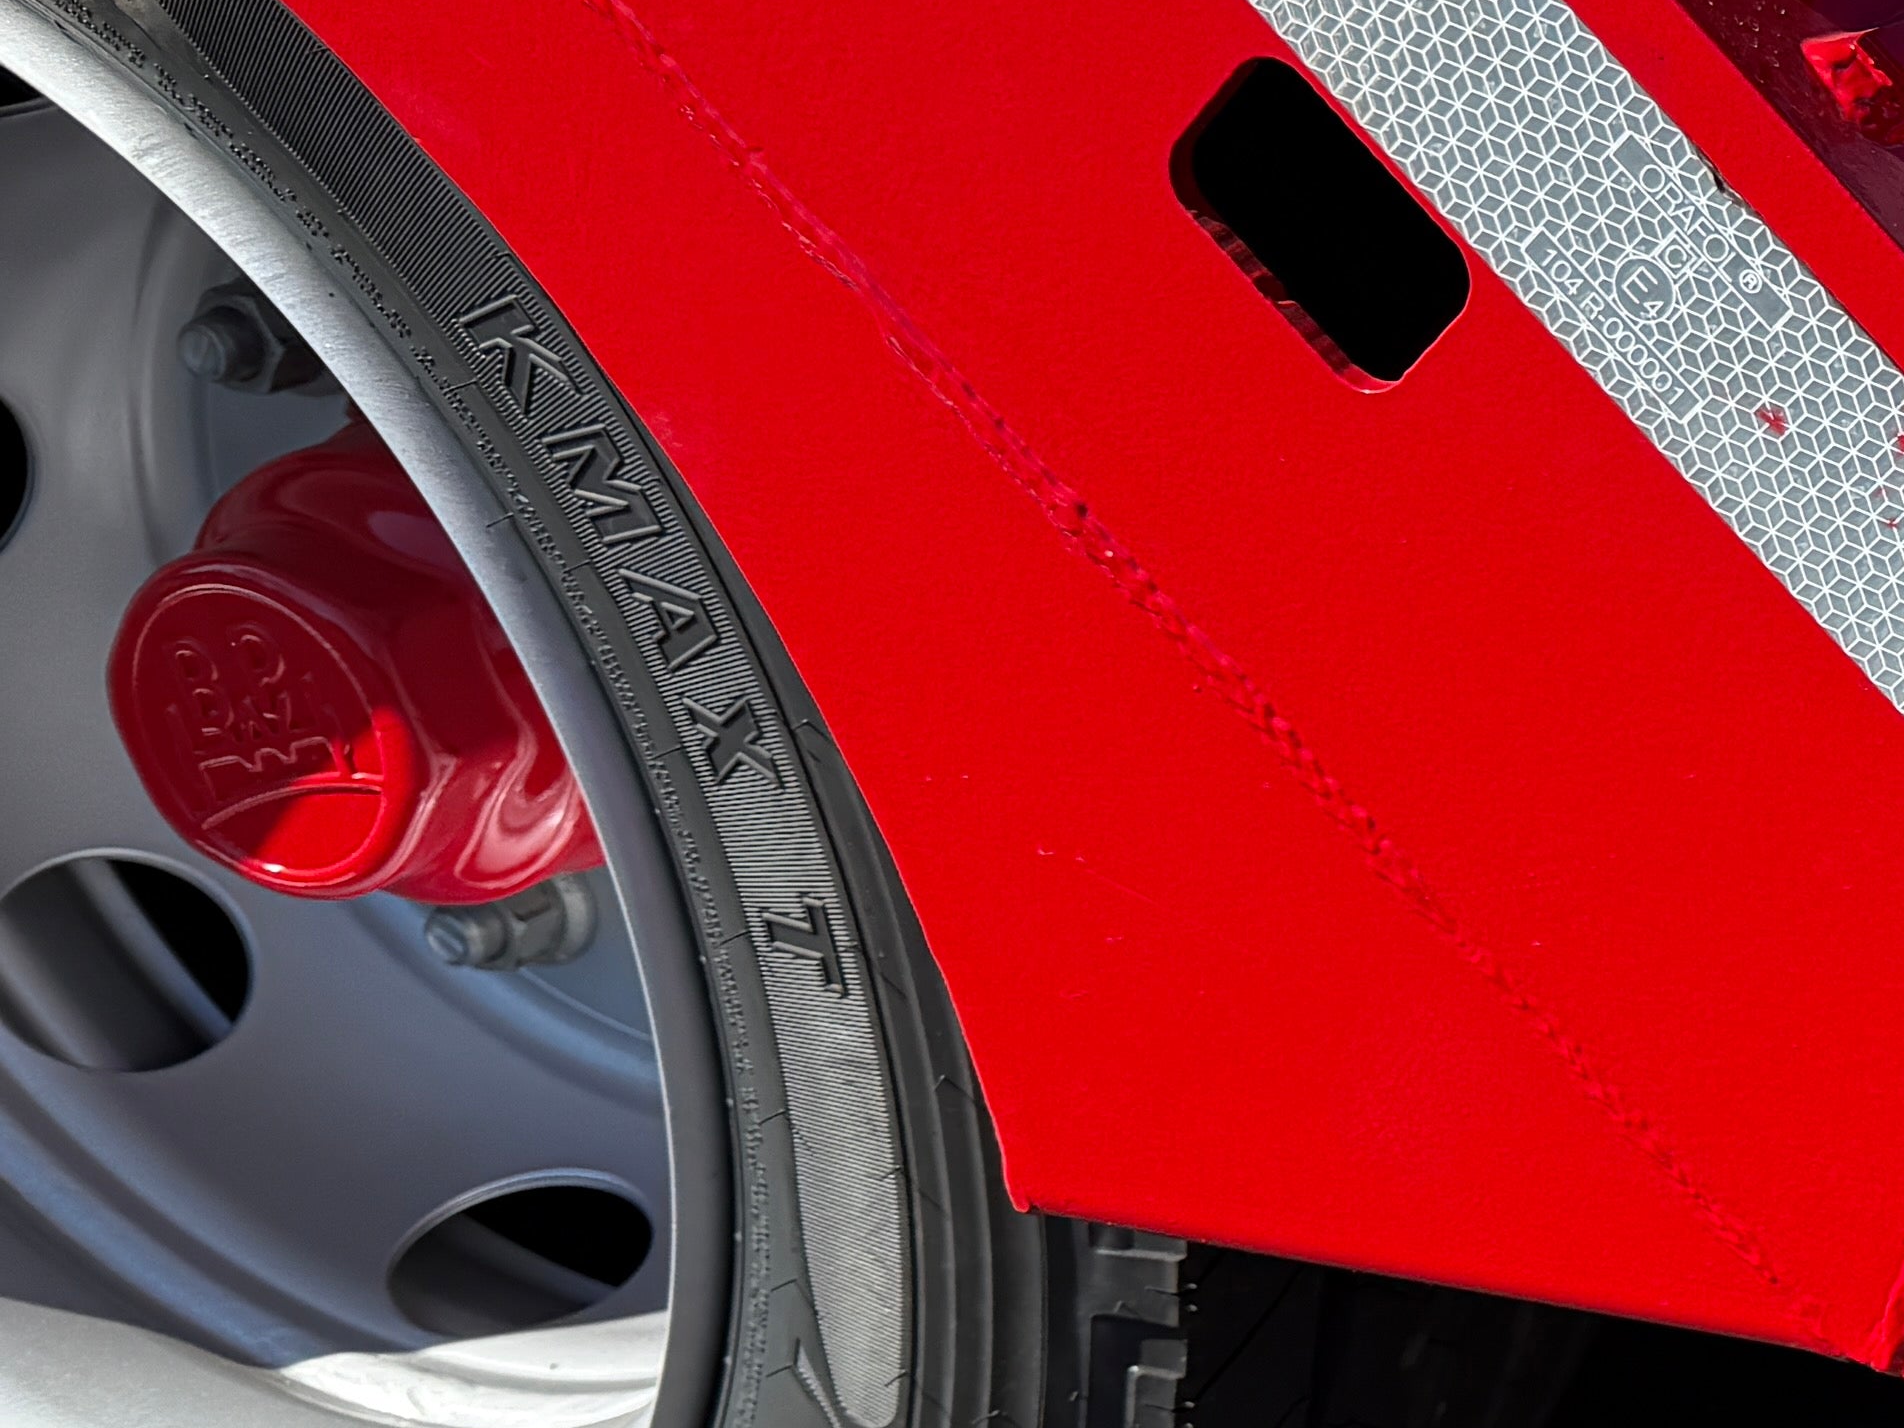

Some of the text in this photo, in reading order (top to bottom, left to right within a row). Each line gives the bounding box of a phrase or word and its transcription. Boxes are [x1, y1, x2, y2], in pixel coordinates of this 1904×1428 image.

[1542, 248, 1685, 405] 104 R-000001
[457, 293, 787, 791] KMAX
[761, 894, 845, 998] T
